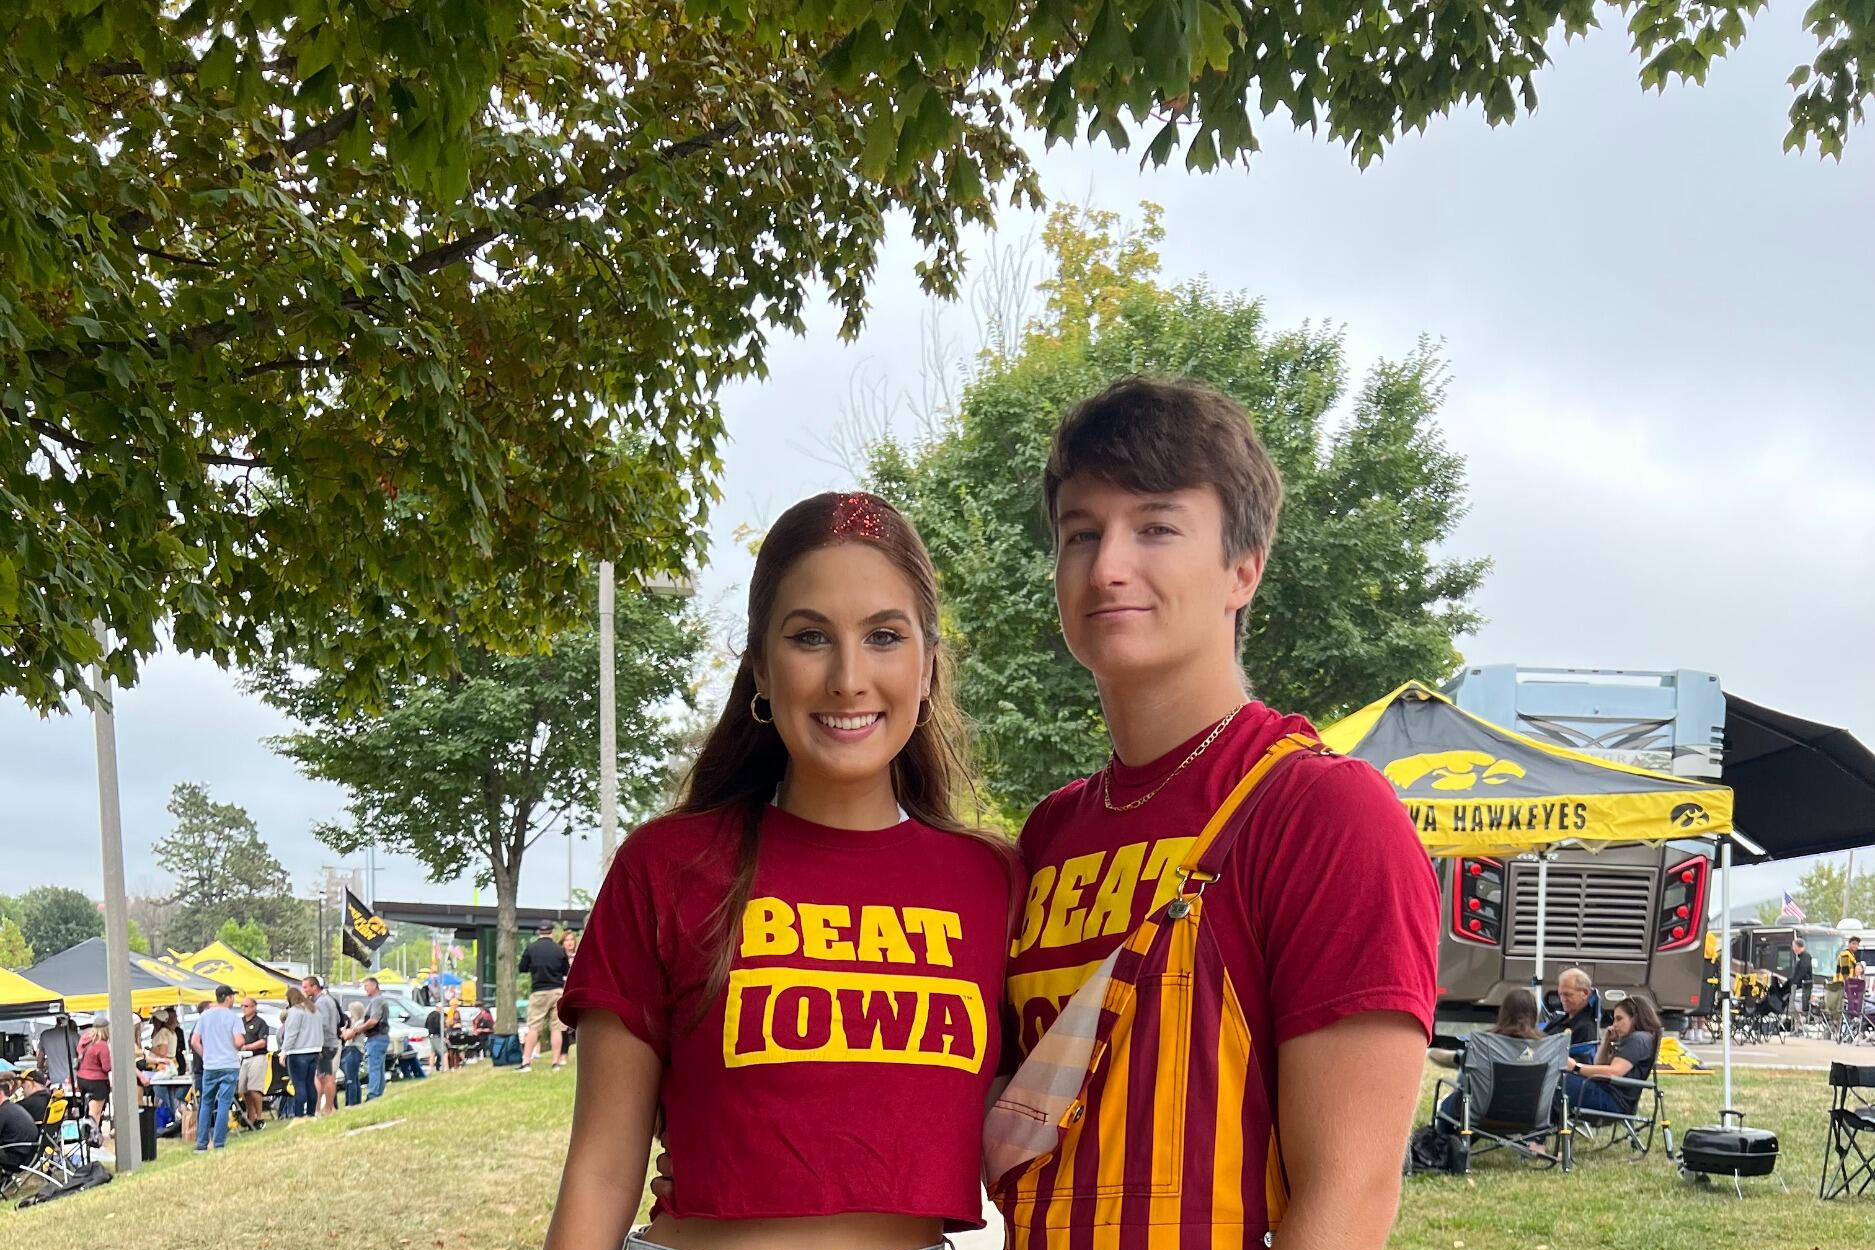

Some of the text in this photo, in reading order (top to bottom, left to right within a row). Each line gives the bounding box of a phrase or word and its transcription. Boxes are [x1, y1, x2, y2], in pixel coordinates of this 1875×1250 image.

[1453, 803, 1588, 832] HAWKEYES
[740, 896, 963, 968] BEAT
[1010, 836, 1209, 959] BEAT
[734, 985, 976, 1061] IOWA
